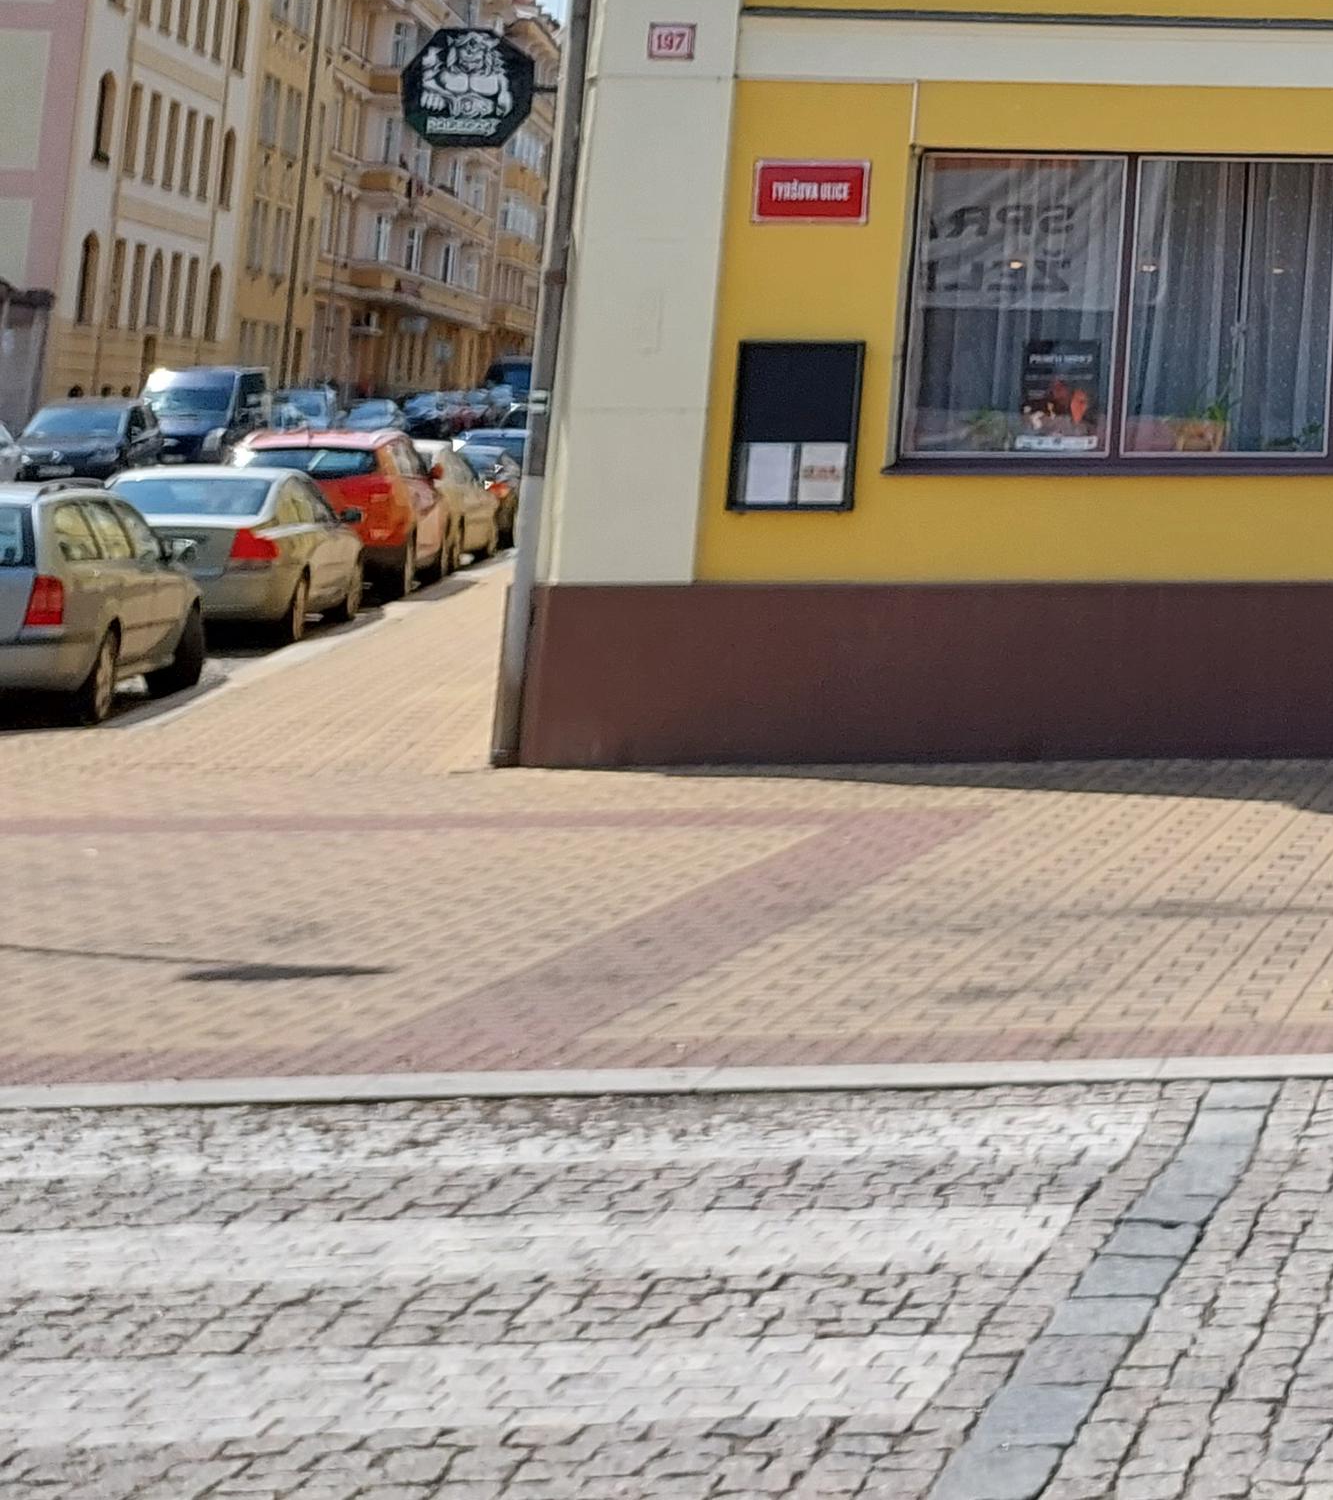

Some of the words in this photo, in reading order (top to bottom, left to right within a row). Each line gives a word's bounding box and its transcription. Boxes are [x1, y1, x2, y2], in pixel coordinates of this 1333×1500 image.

[656, 32, 687, 51] 197
[772, 178, 818, 202] TYRŠOVA
[820, 181, 851, 202] ULICE
